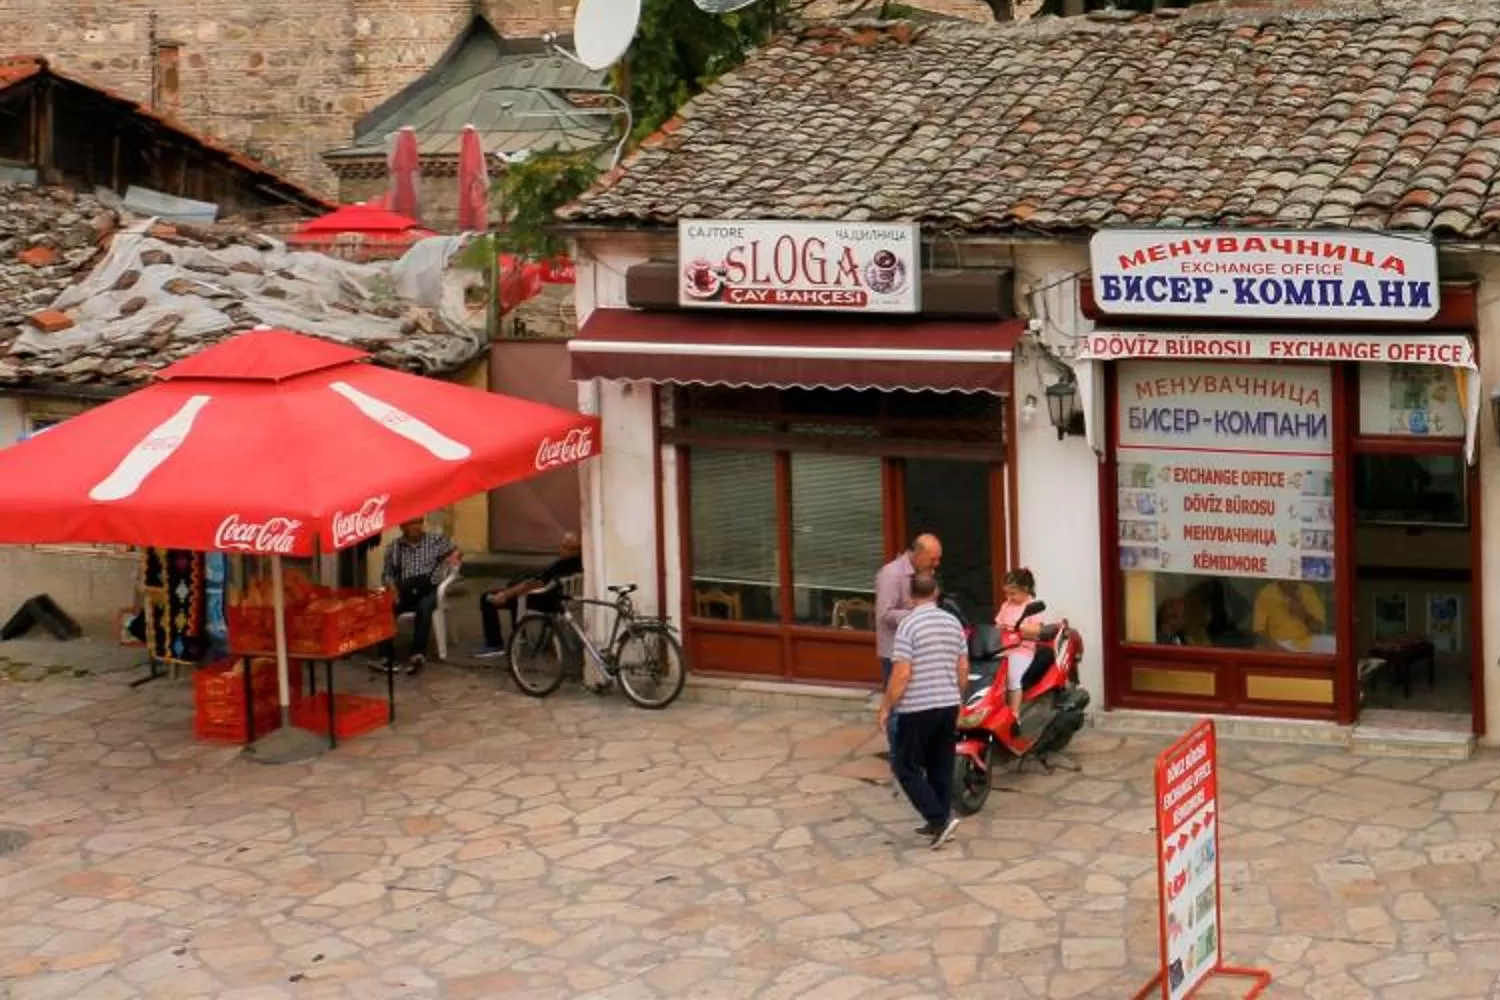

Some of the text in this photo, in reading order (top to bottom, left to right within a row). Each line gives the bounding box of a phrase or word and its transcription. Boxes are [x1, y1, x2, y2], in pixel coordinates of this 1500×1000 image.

[725, 234, 862, 287] SLOGA
[1118, 236, 1406, 276] МЕНУВАЧНИЦА
[1180, 261, 1344, 276] EXCHANGE OFFICE
[731, 289, 768, 303] ÇAY
[1164, 335, 1251, 355] BÜROSU
[1269, 340, 1381, 359] EXCHANGE
[1387, 343, 1463, 363] OFFICE
[1135, 375, 1321, 408] МЕНУВАЧНИЦА
[1173, 467, 1239, 486] EXCHANGE
[1241, 470, 1285, 488] OFFICE
[214, 513, 302, 553] Coca-Cola
[1183, 524, 1277, 547] МЕНУВАЧНИЦА
